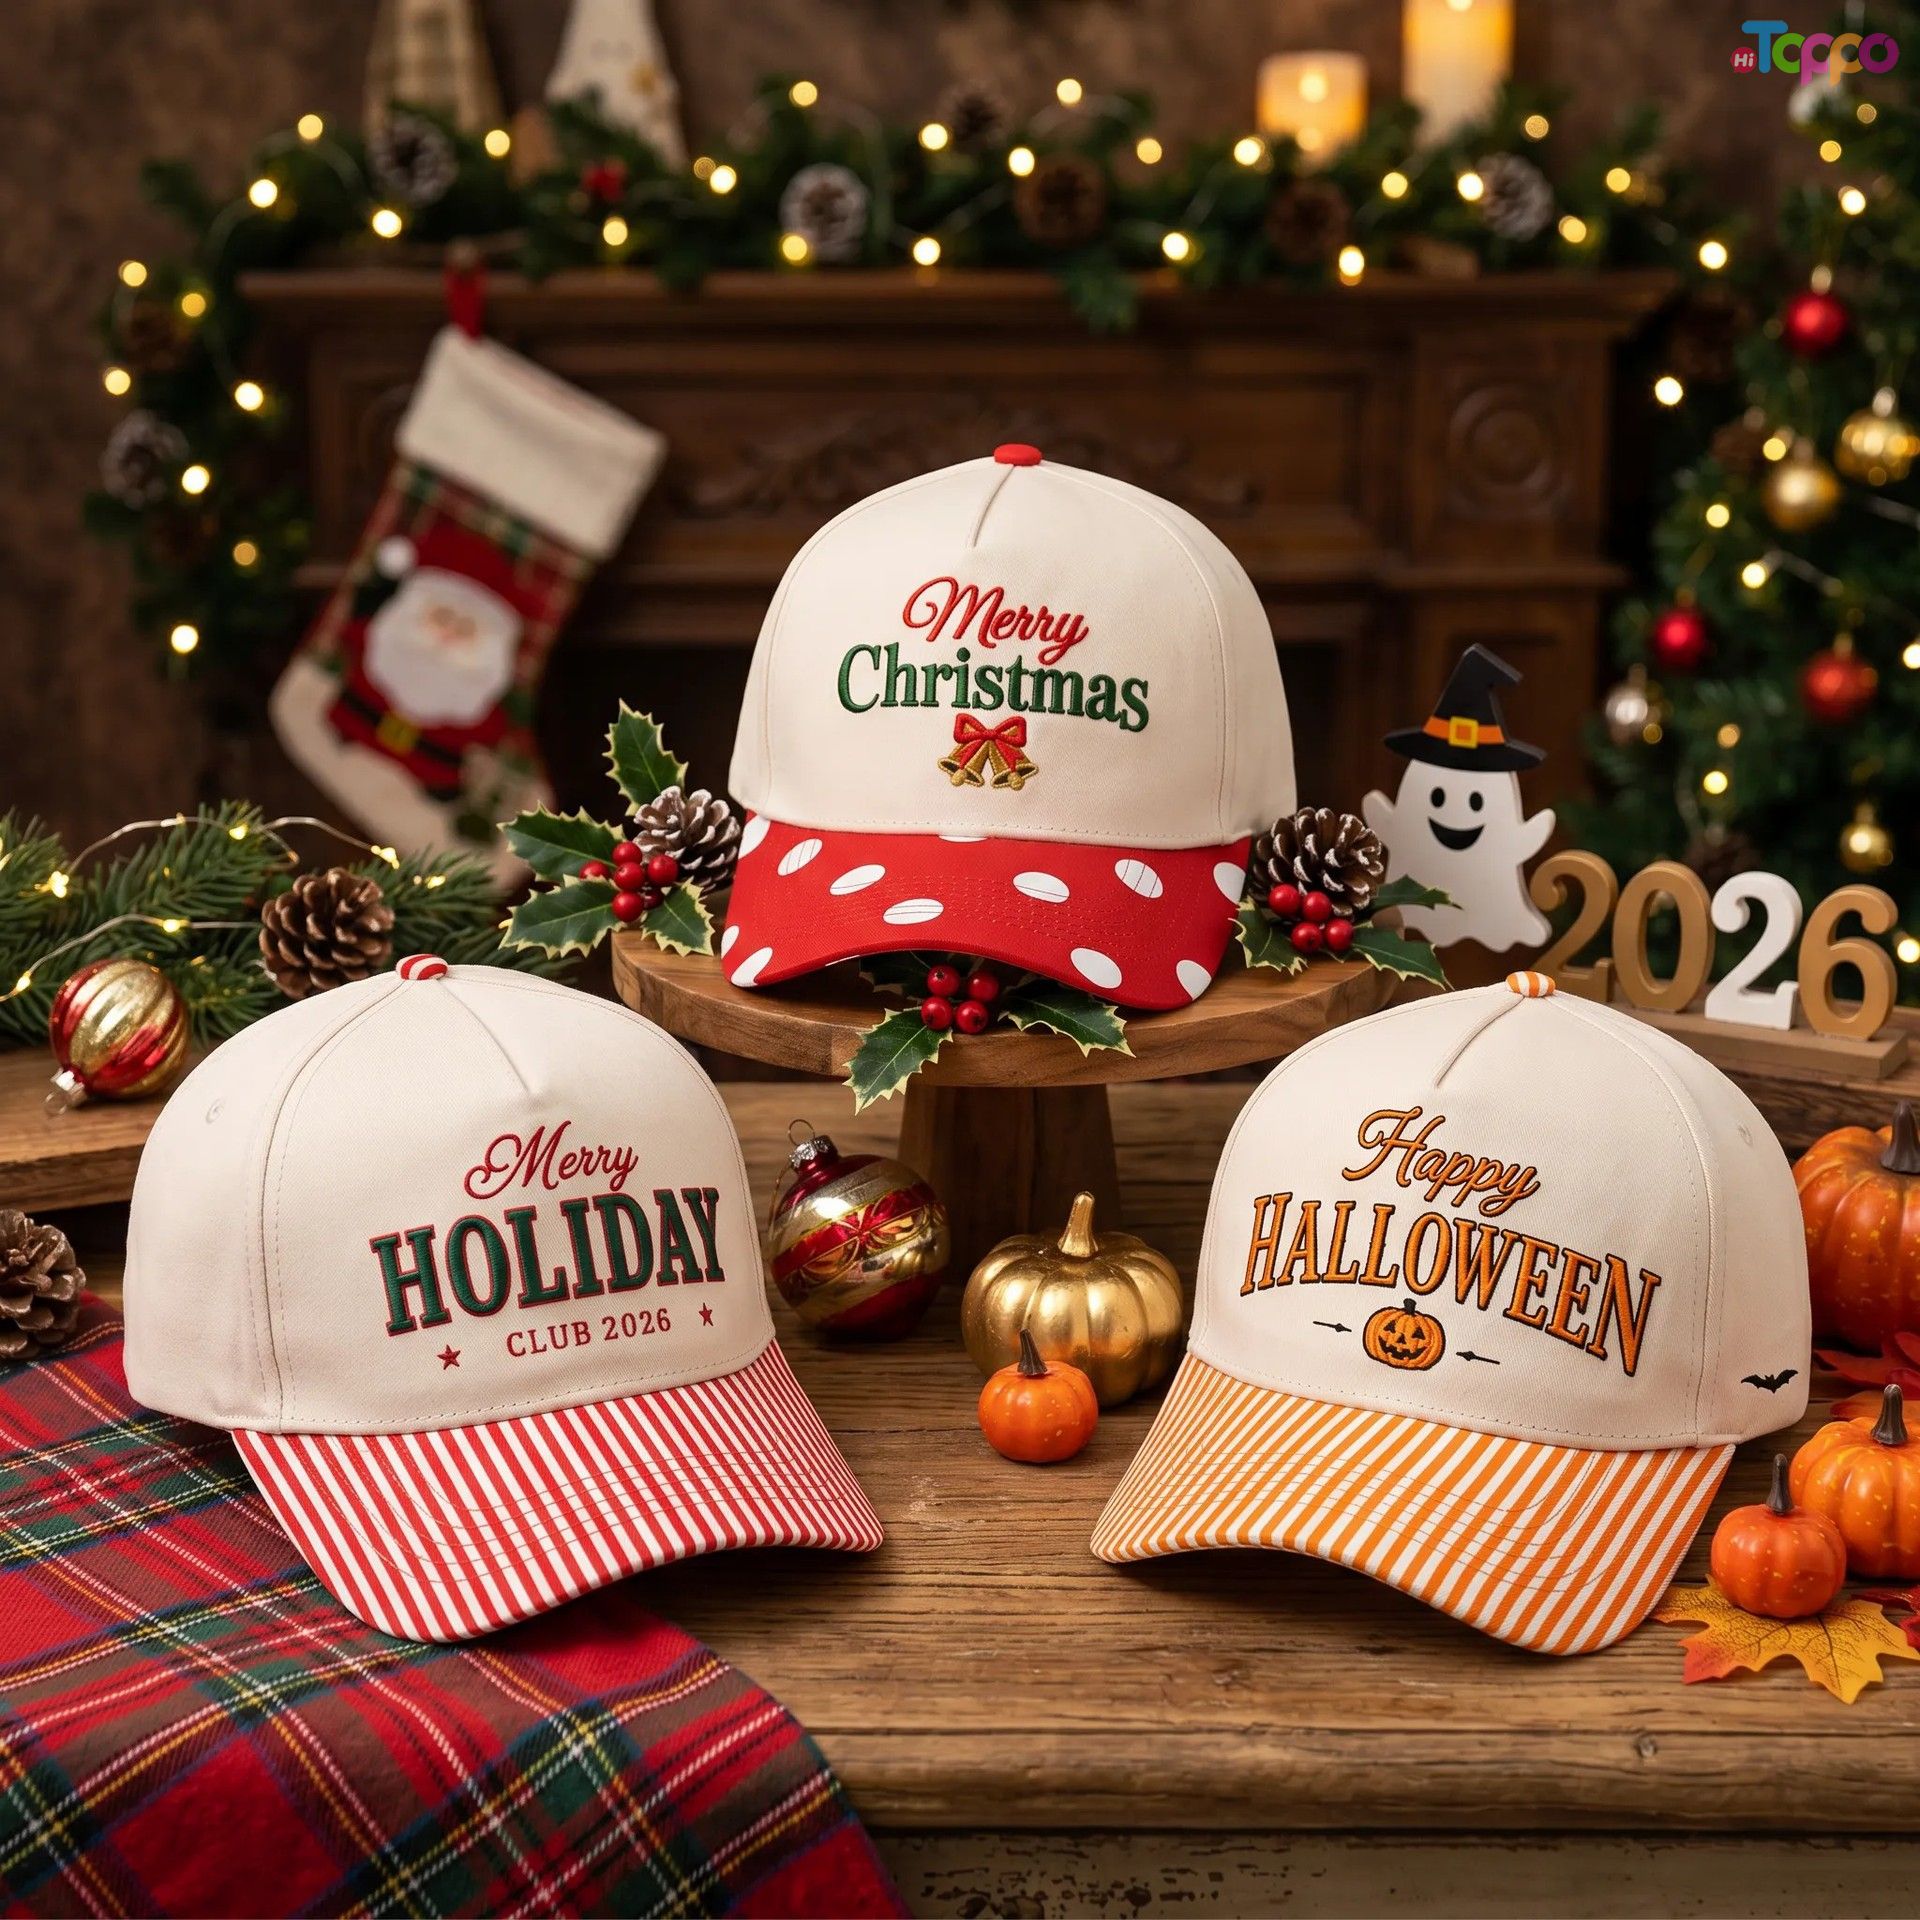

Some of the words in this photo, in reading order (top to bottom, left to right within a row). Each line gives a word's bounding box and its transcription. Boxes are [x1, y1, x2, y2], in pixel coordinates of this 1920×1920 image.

[902, 576, 1089, 666] Merry
[837, 642, 1149, 732] Christmas
[1529, 849, 1898, 1040] 2026
[464, 1120, 638, 1199] Merry
[1342, 1106, 1541, 1217] Happy
[369, 1187, 725, 1337] HOLIDAY
[1240, 1192, 1662, 1377] HALLOWEEN
[506, 1321, 592, 1357] CLUB
[601, 1308, 672, 1341] 2026
